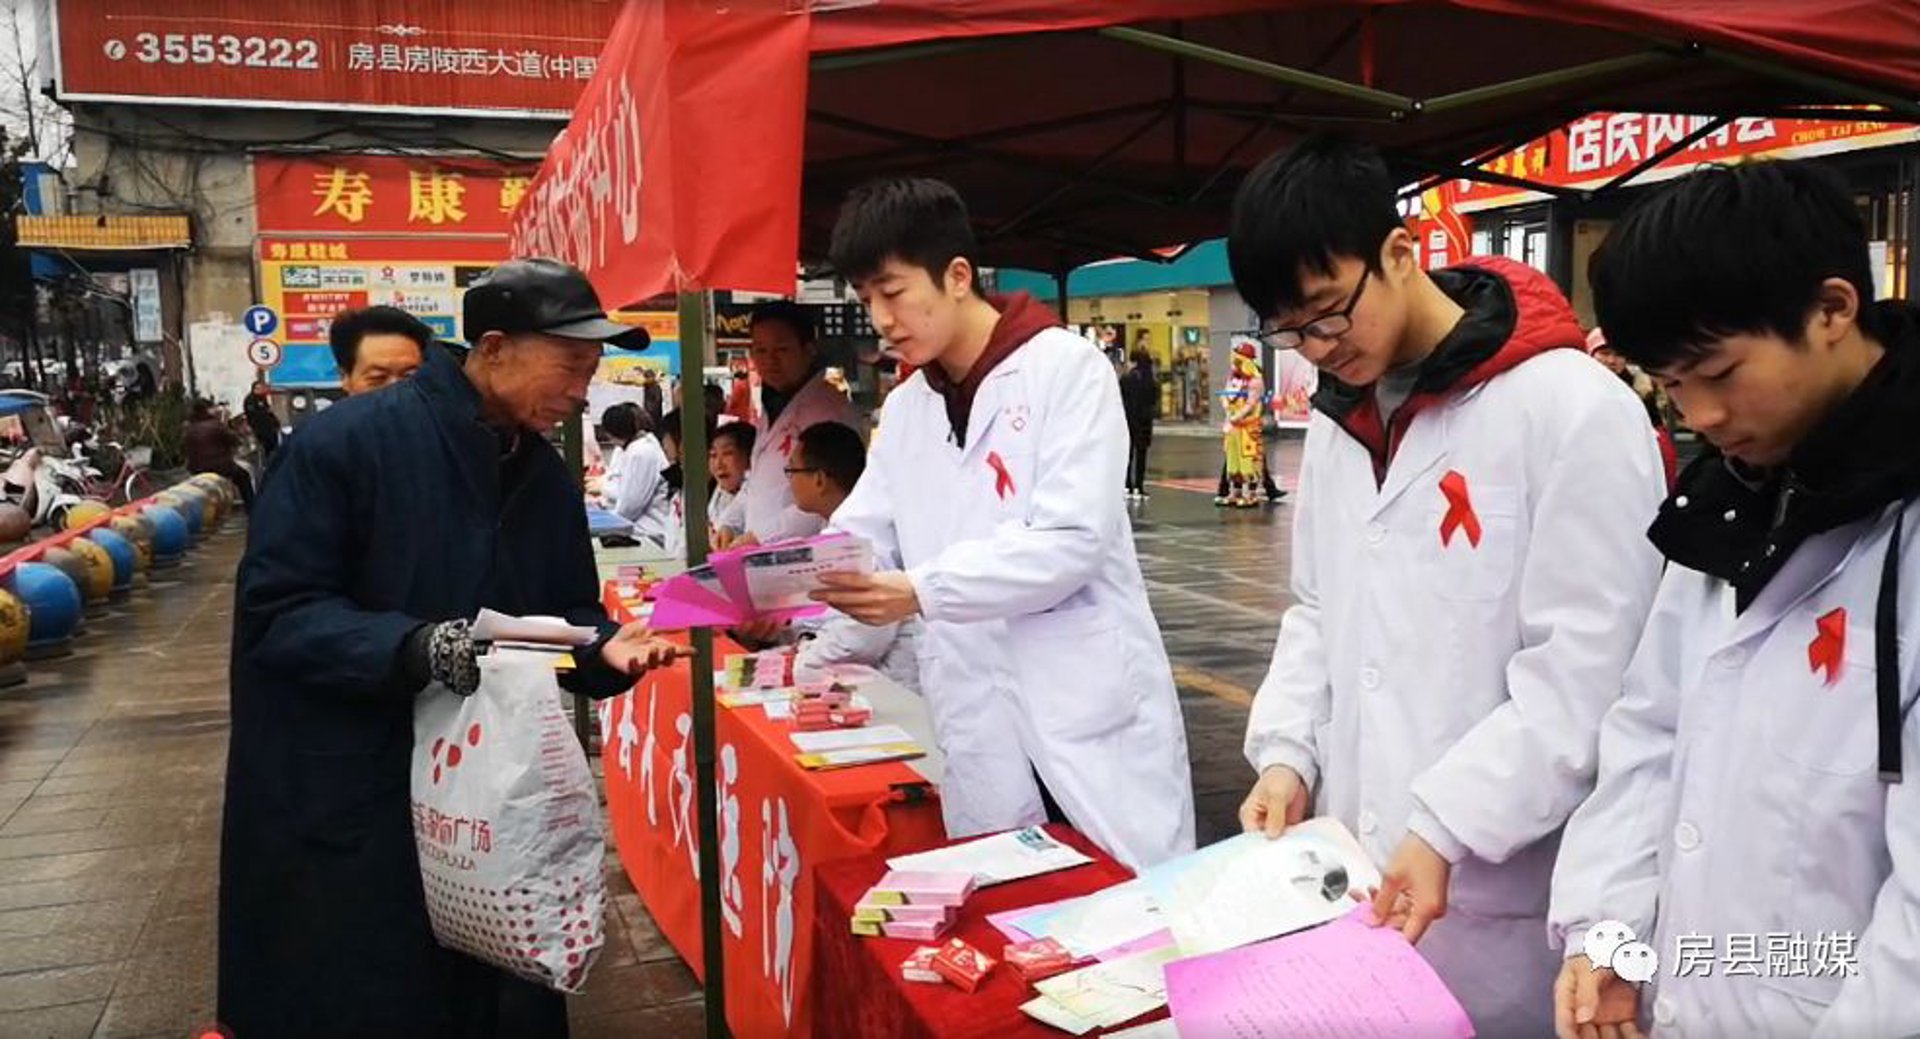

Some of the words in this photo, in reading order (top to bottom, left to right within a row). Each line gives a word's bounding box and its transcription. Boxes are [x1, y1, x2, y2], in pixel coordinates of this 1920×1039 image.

[135, 32, 320, 70] 3553222
[253, 313, 270, 333] P
[260, 345, 270, 361] 5
